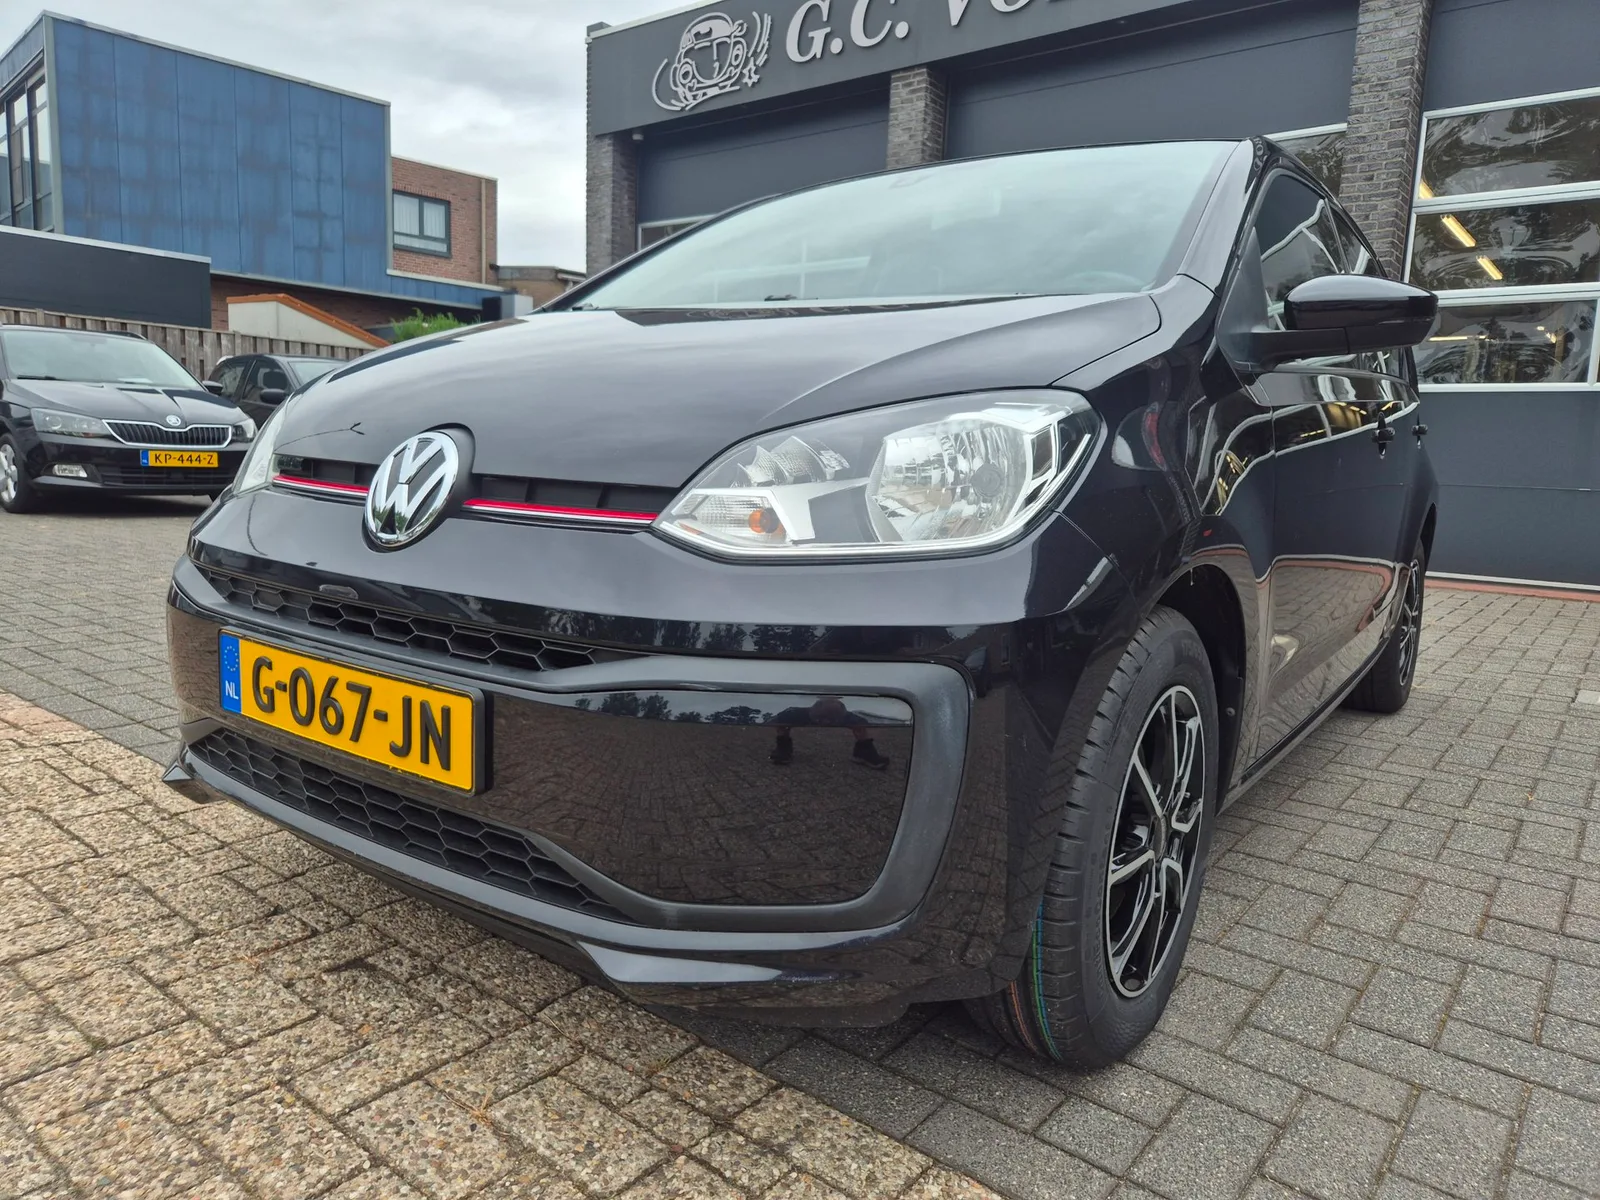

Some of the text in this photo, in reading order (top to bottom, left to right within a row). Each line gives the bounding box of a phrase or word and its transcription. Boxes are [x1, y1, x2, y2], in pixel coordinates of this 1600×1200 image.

[786, 0, 909, 63] G.C.
[154, 453, 214, 465] KP-444-Z
[225, 679, 239, 700] NL
[252, 656, 451, 771] G-067-JN
